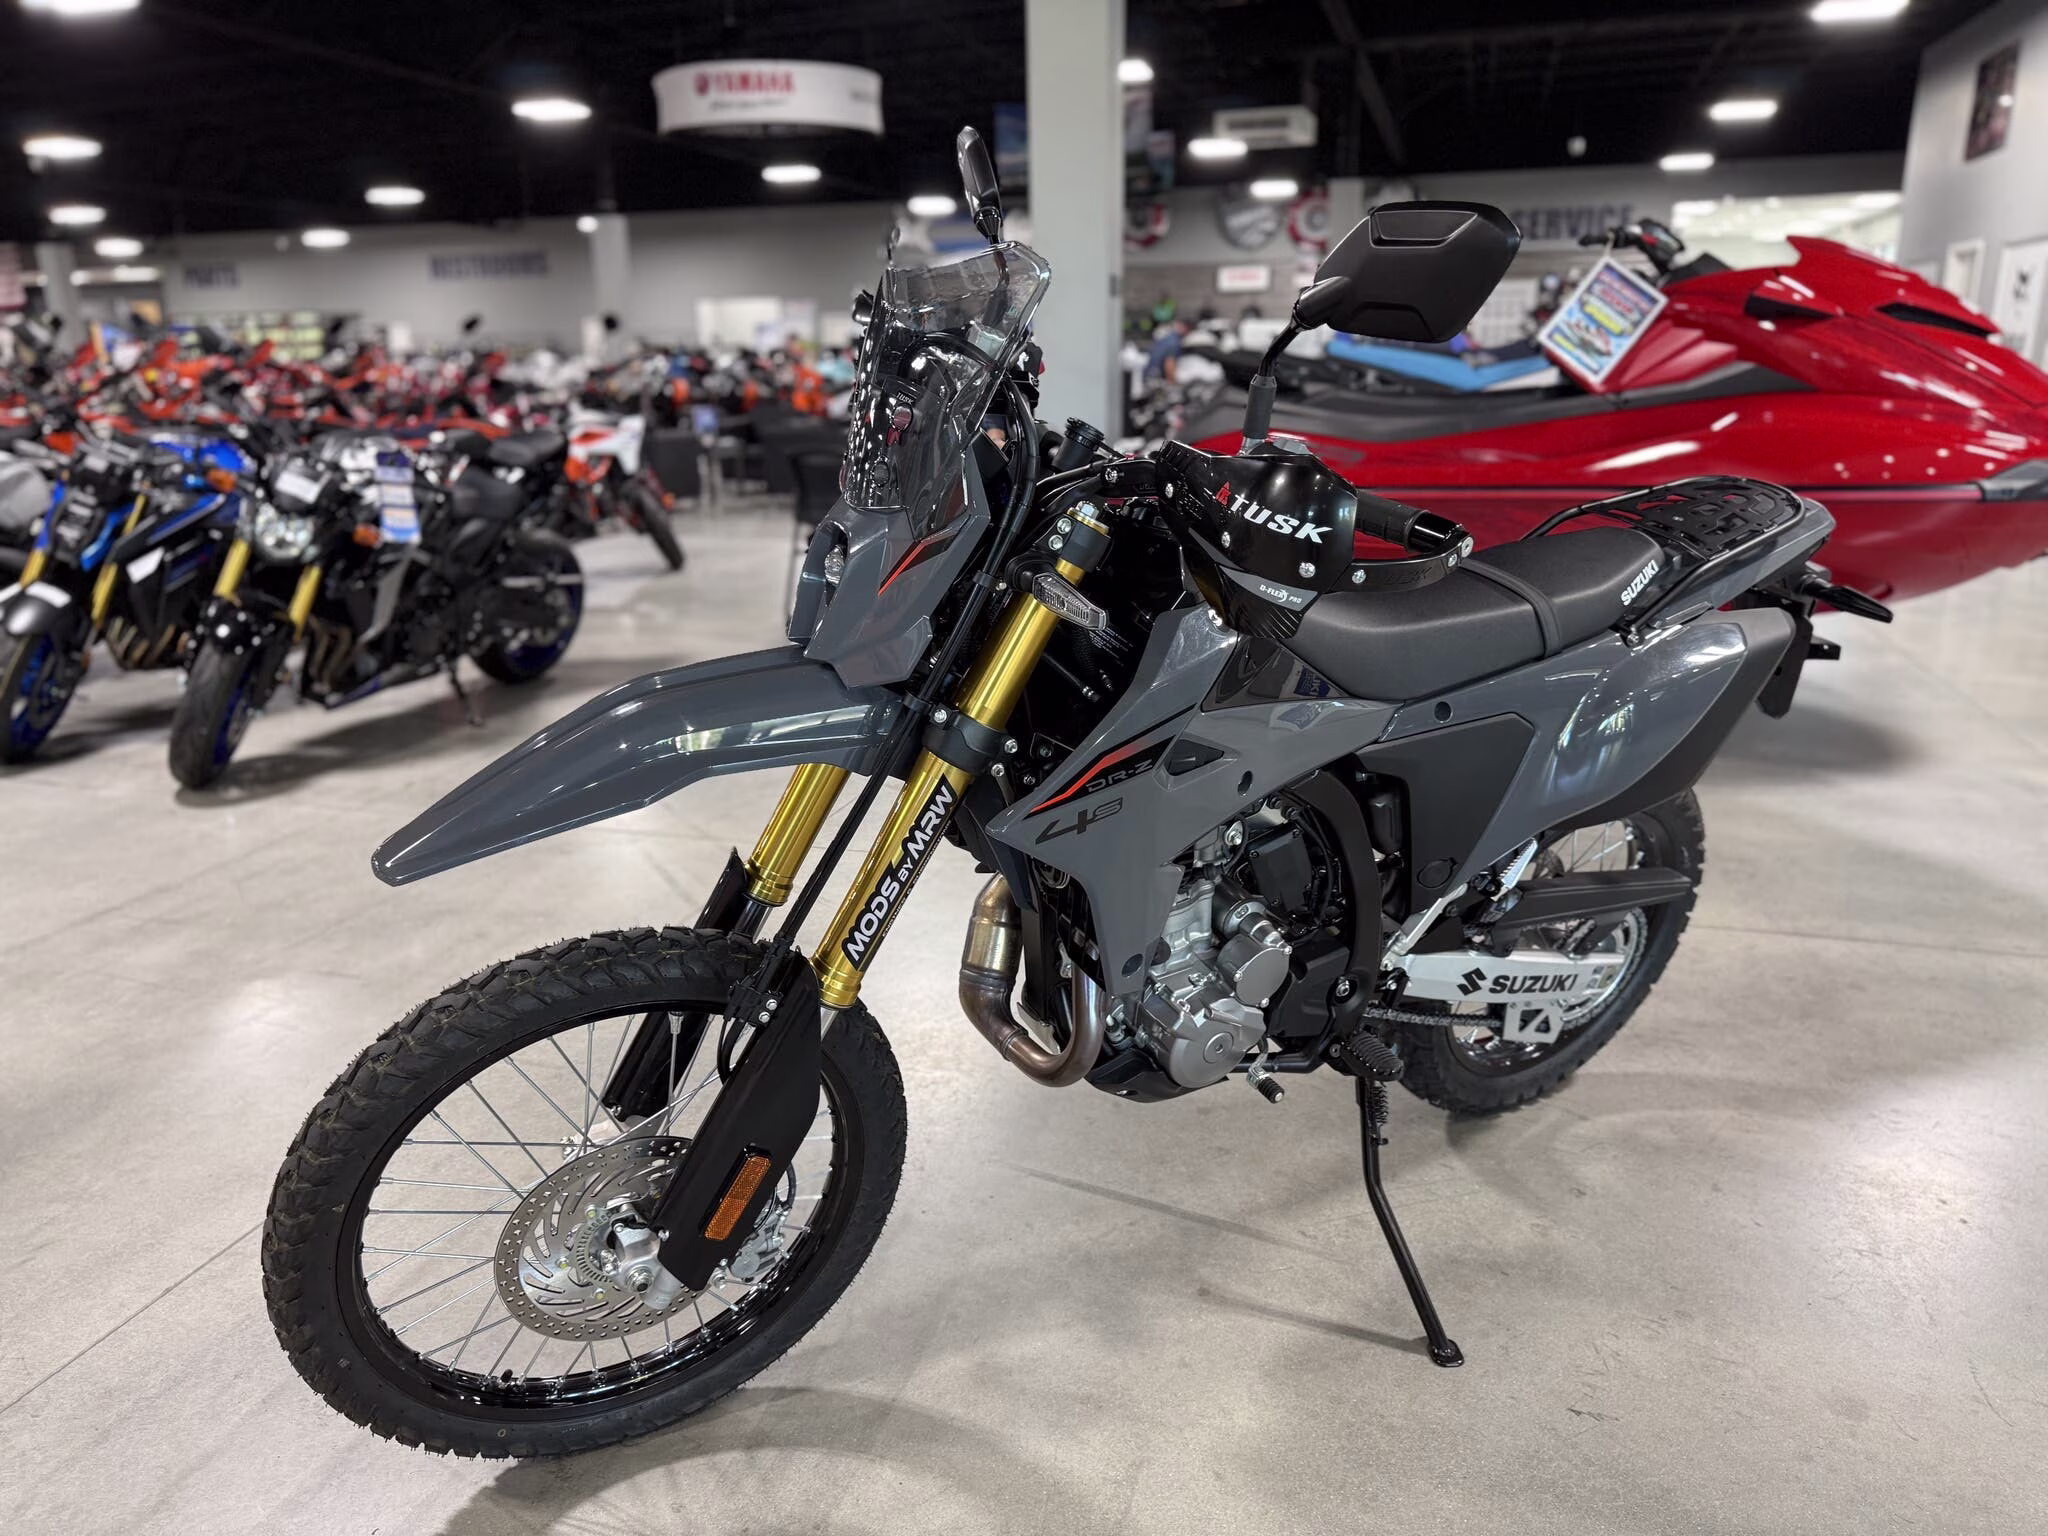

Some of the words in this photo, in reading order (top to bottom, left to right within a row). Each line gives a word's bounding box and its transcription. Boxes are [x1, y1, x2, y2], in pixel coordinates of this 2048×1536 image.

[1230, 494, 1333, 544] TUSK
[1620, 559, 1659, 606] SUZUKI
[1085, 758, 1153, 793] DR-Z
[846, 875, 900, 961] MODS
[897, 856, 914, 882] BY
[907, 784, 953, 861] MRW
[1488, 974, 1579, 995] SUZUKI
